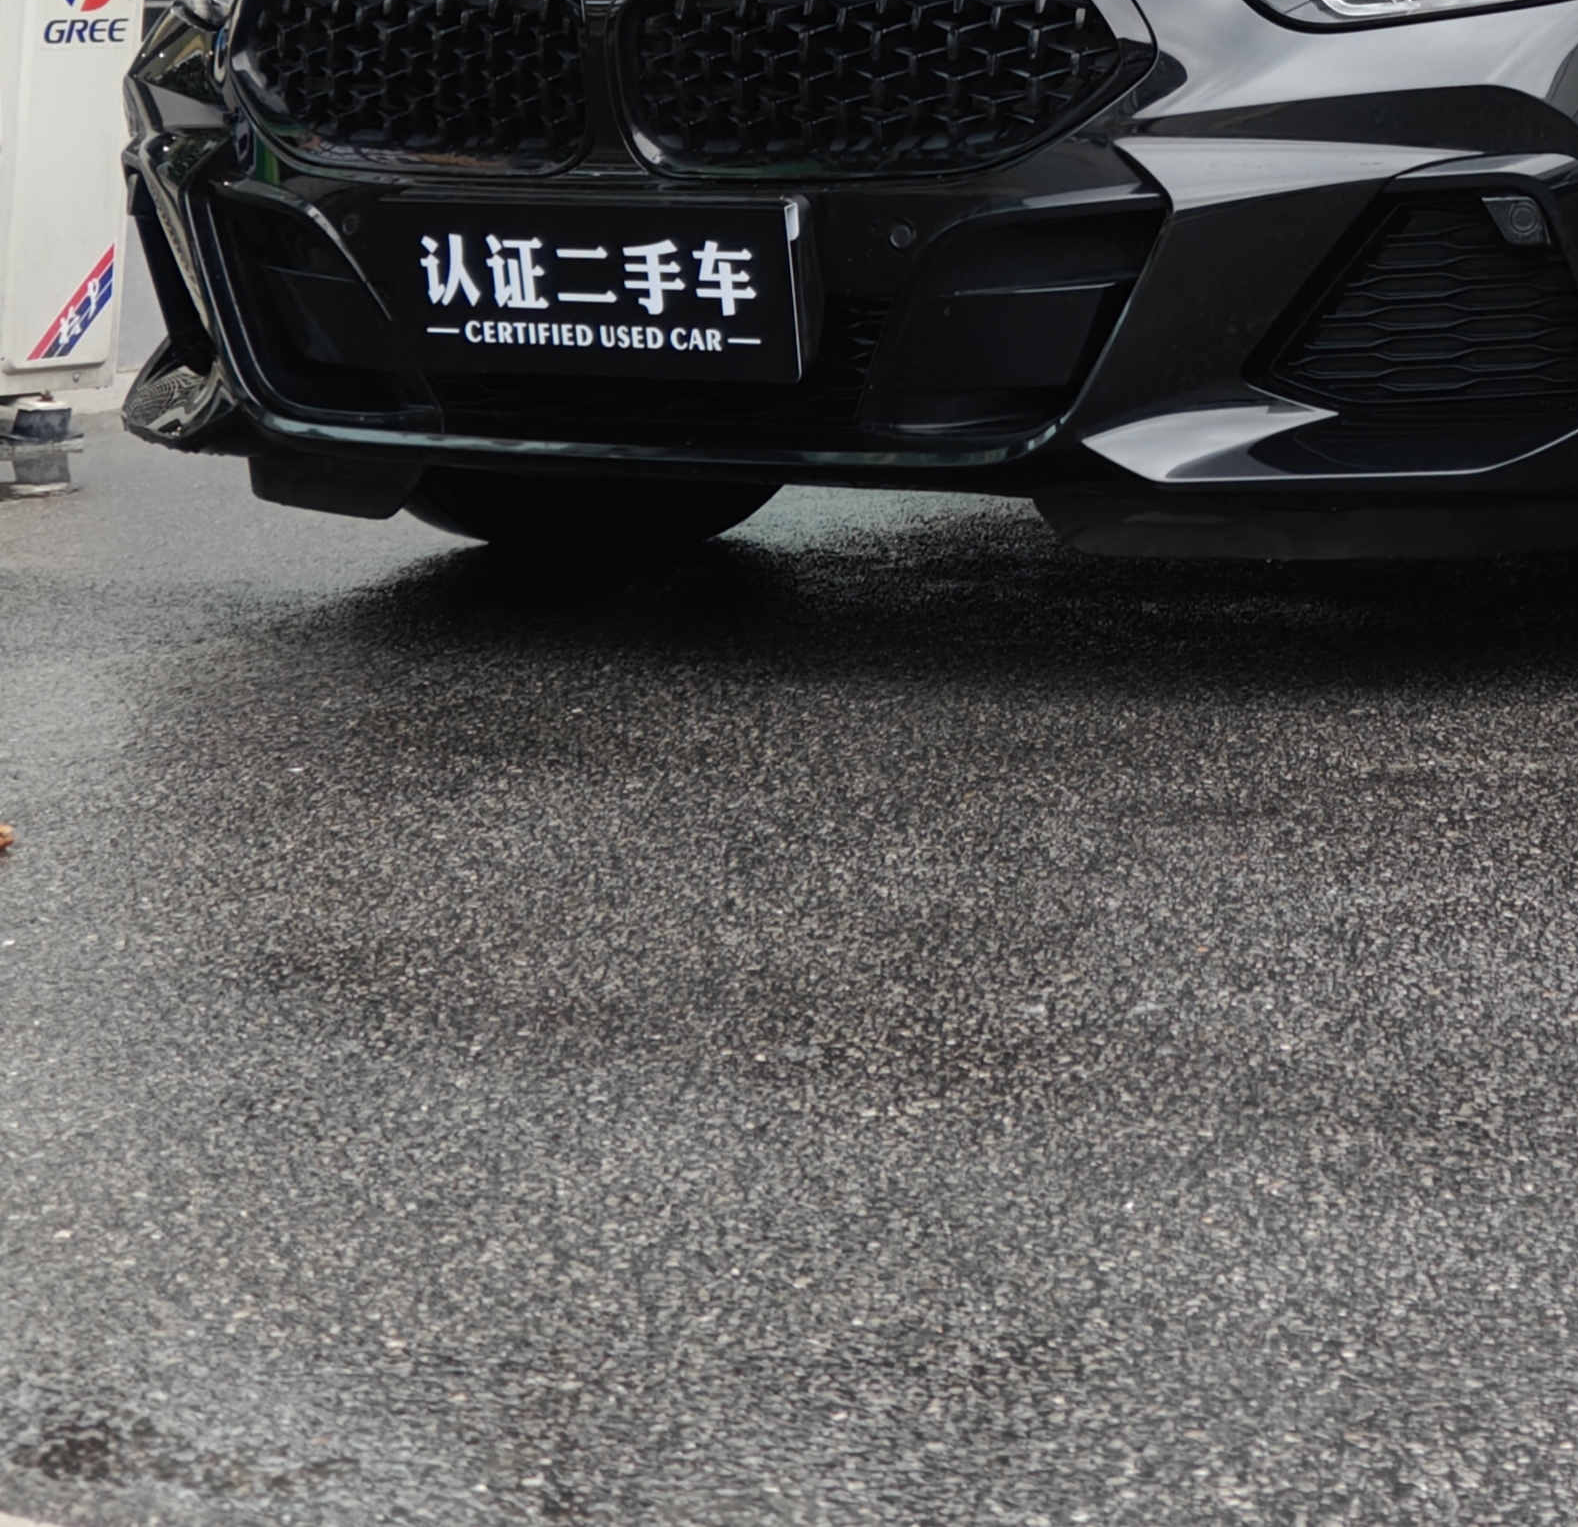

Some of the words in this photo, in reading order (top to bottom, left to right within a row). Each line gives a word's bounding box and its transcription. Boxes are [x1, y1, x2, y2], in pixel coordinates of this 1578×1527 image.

[44, 18, 128, 44] GREE
[419, 233, 757, 317] 认证二手车
[464, 319, 595, 348] CERTIFIED
[599, 324, 665, 351] USED
[669, 327, 723, 353] CAR
